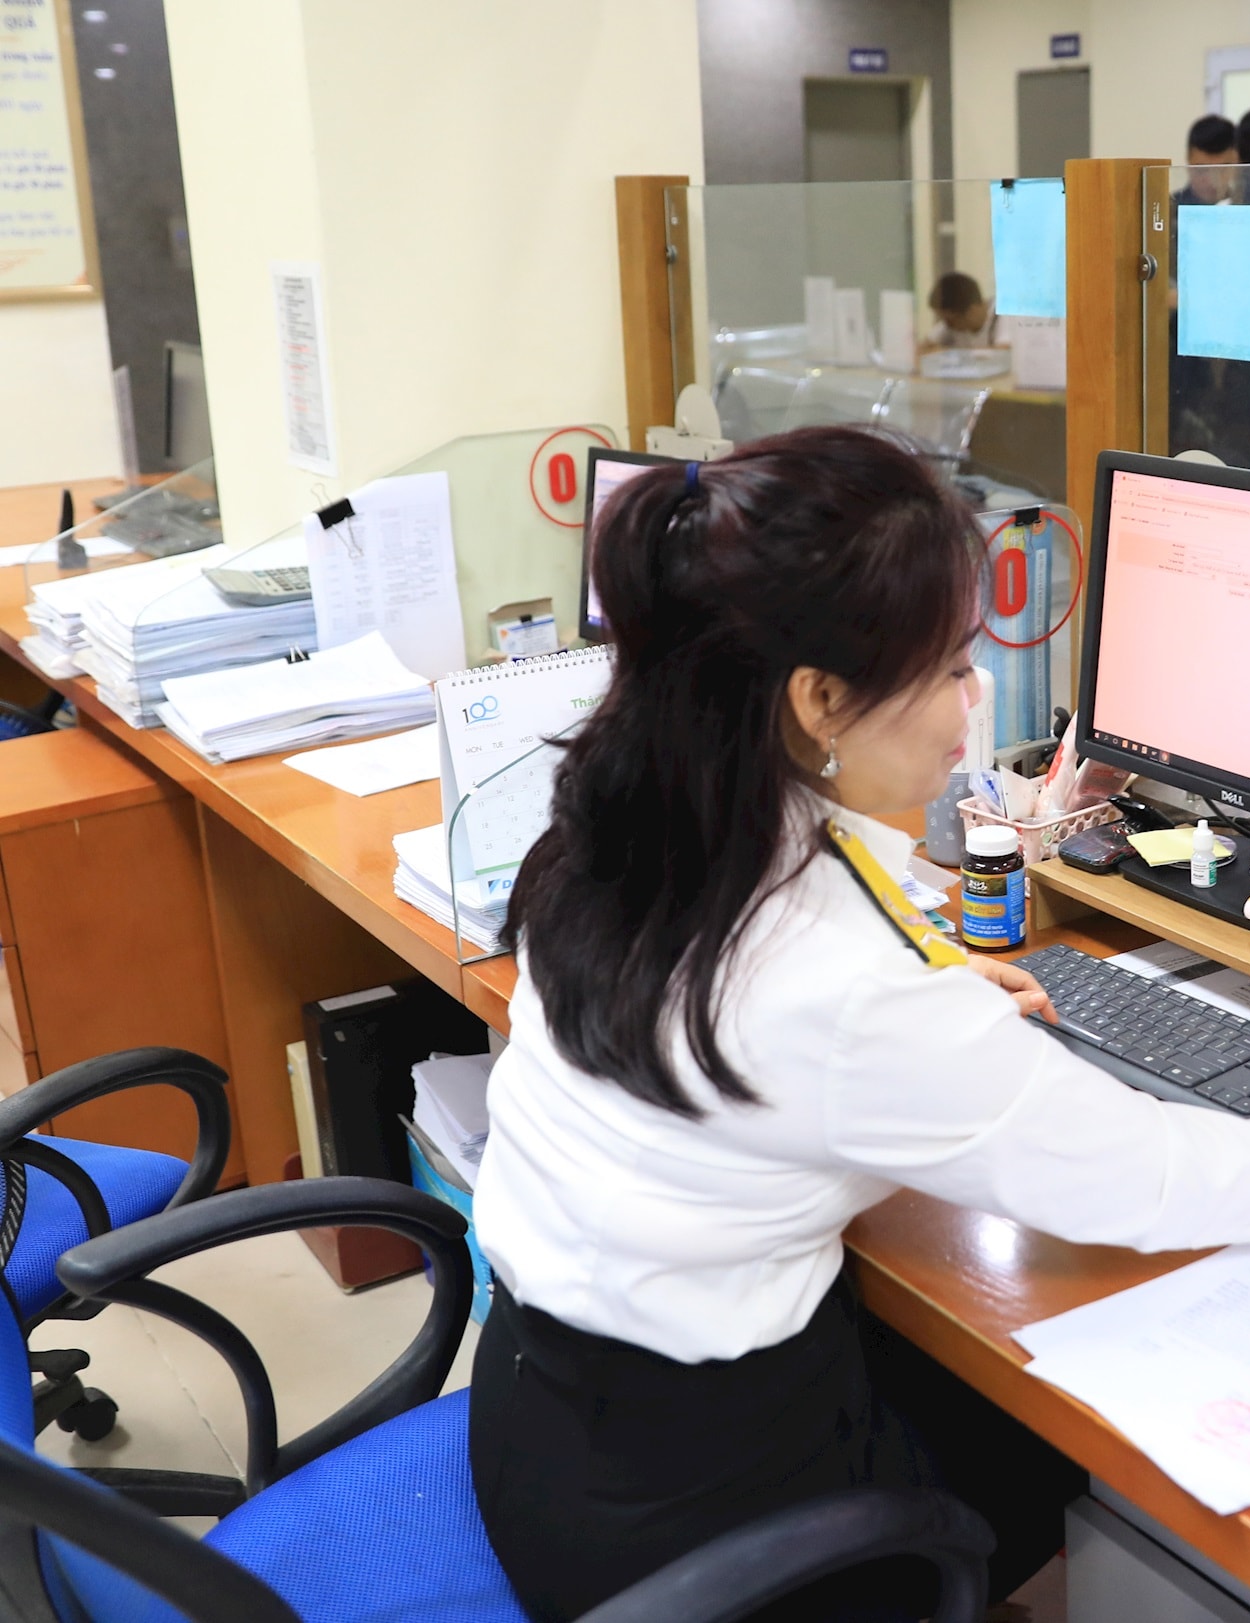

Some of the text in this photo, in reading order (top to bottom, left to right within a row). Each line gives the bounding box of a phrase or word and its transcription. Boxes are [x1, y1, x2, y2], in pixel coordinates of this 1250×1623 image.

[462, 695, 498, 723] 100
[570, 695, 606, 709] Thán
[465, 745, 482, 753] MON
[519, 735, 534, 744] WED
[1220, 790, 1245, 807] DELL
[536, 810, 545, 818] 20
